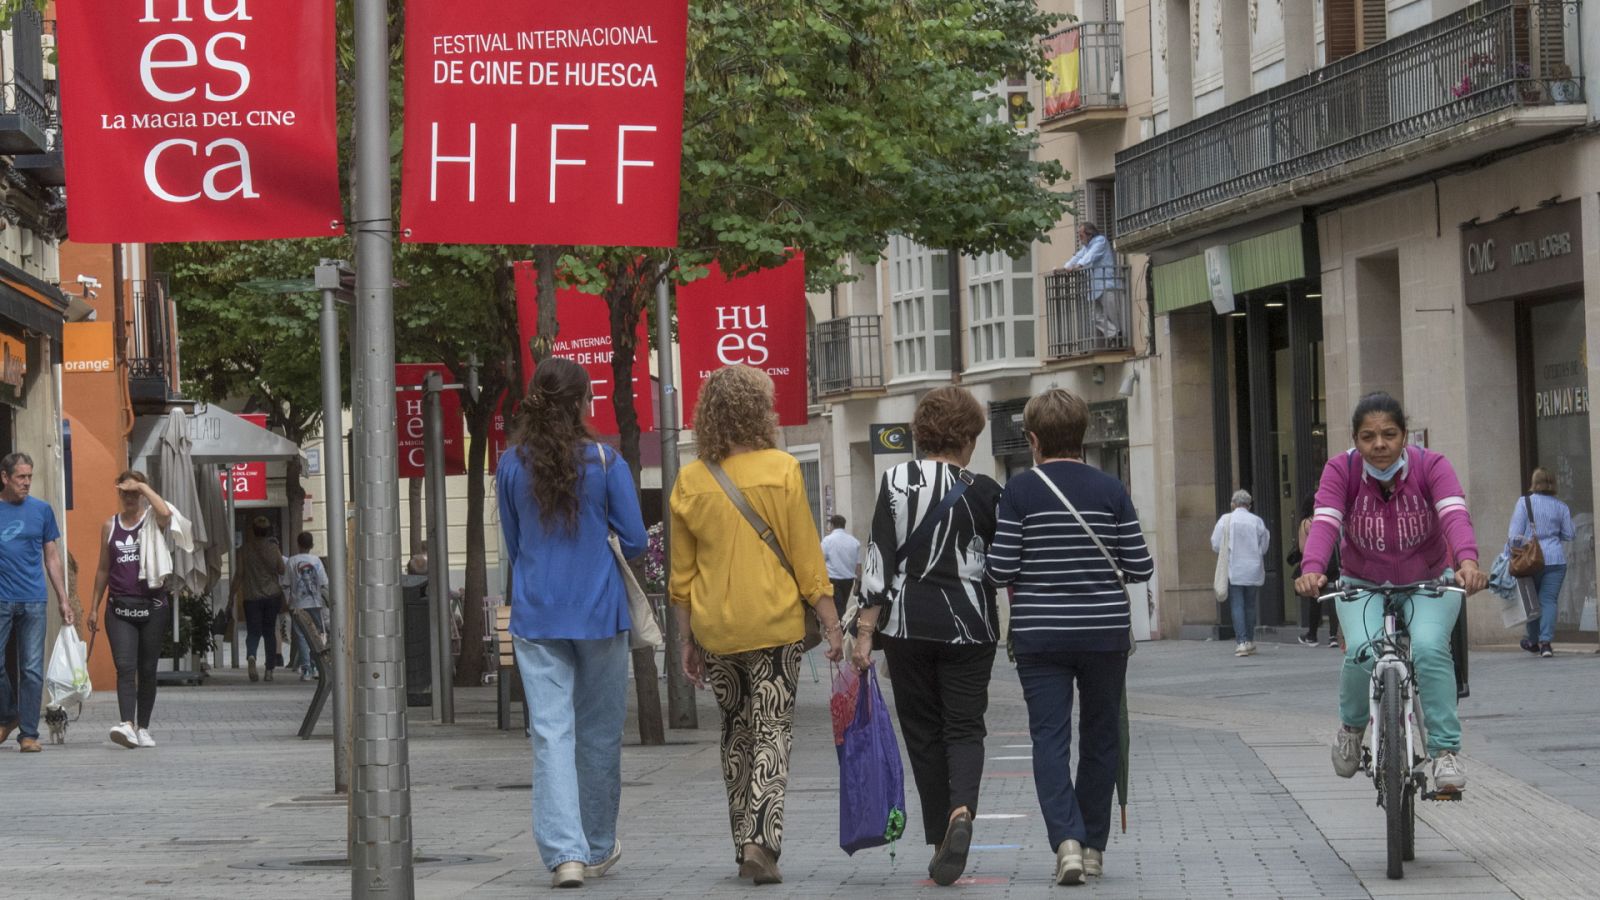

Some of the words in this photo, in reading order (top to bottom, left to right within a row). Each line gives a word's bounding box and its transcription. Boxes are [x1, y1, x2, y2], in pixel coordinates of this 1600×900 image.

[433, 33, 514, 55] FESTIVAL
[517, 25, 658, 51] INTERNACIONAL
[139, 31, 251, 103] es
[433, 60, 464, 84] DE
[470, 60, 523, 85] CINE
[529, 62, 559, 86] DE
[565, 62, 658, 88] HUESCA
[101, 114, 126, 129] La
[143, 137, 260, 203] ca
[1468, 238, 1496, 275] CMC
[1511, 241, 1537, 266] MODA
[1540, 232, 1571, 259] HOGAR
[715, 304, 769, 330] Hu
[571, 335, 612, 350] INTERNAC
[716, 332, 769, 366] es
[64, 360, 110, 372] orange
[577, 351, 592, 365] DE
[594, 350, 615, 364] HUE
[406, 399, 422, 416] H
[1536, 386, 1590, 417] PRIMAVER
[189, 416, 221, 441] ELATO
[407, 416, 424, 439] e
[116, 553, 140, 563] adida
[115, 607, 150, 618] adidas
